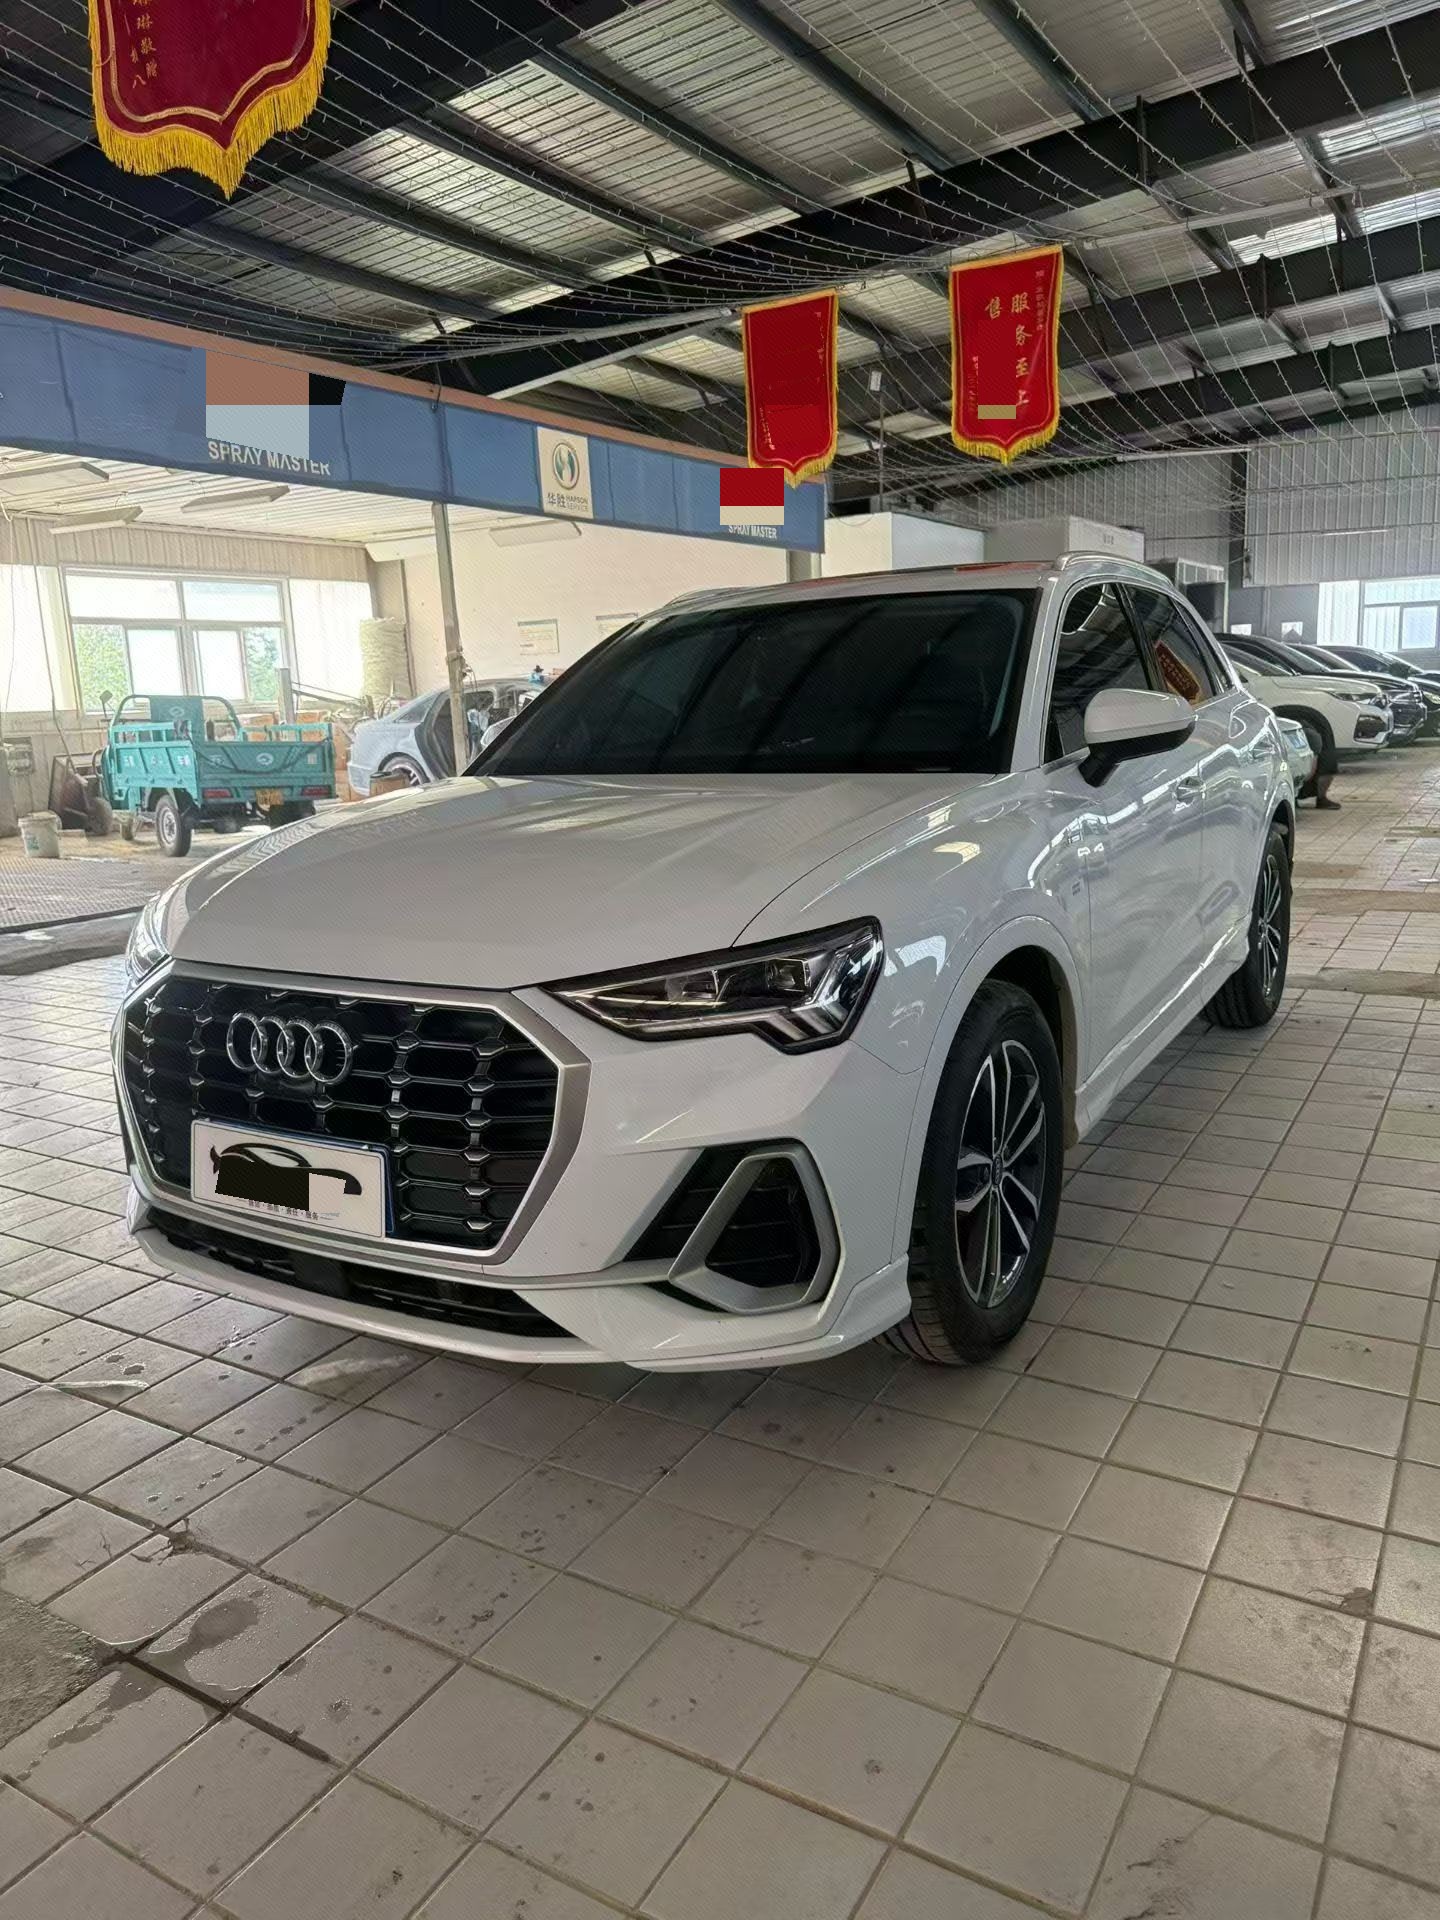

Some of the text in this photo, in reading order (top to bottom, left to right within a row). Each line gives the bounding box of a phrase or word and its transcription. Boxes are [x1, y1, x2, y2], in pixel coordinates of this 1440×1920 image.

[1011, 291, 1032, 406] 服务至上
[207, 440, 331, 475] SPRAY MASTER
[728, 524, 777, 539] SPRAY MASTER
